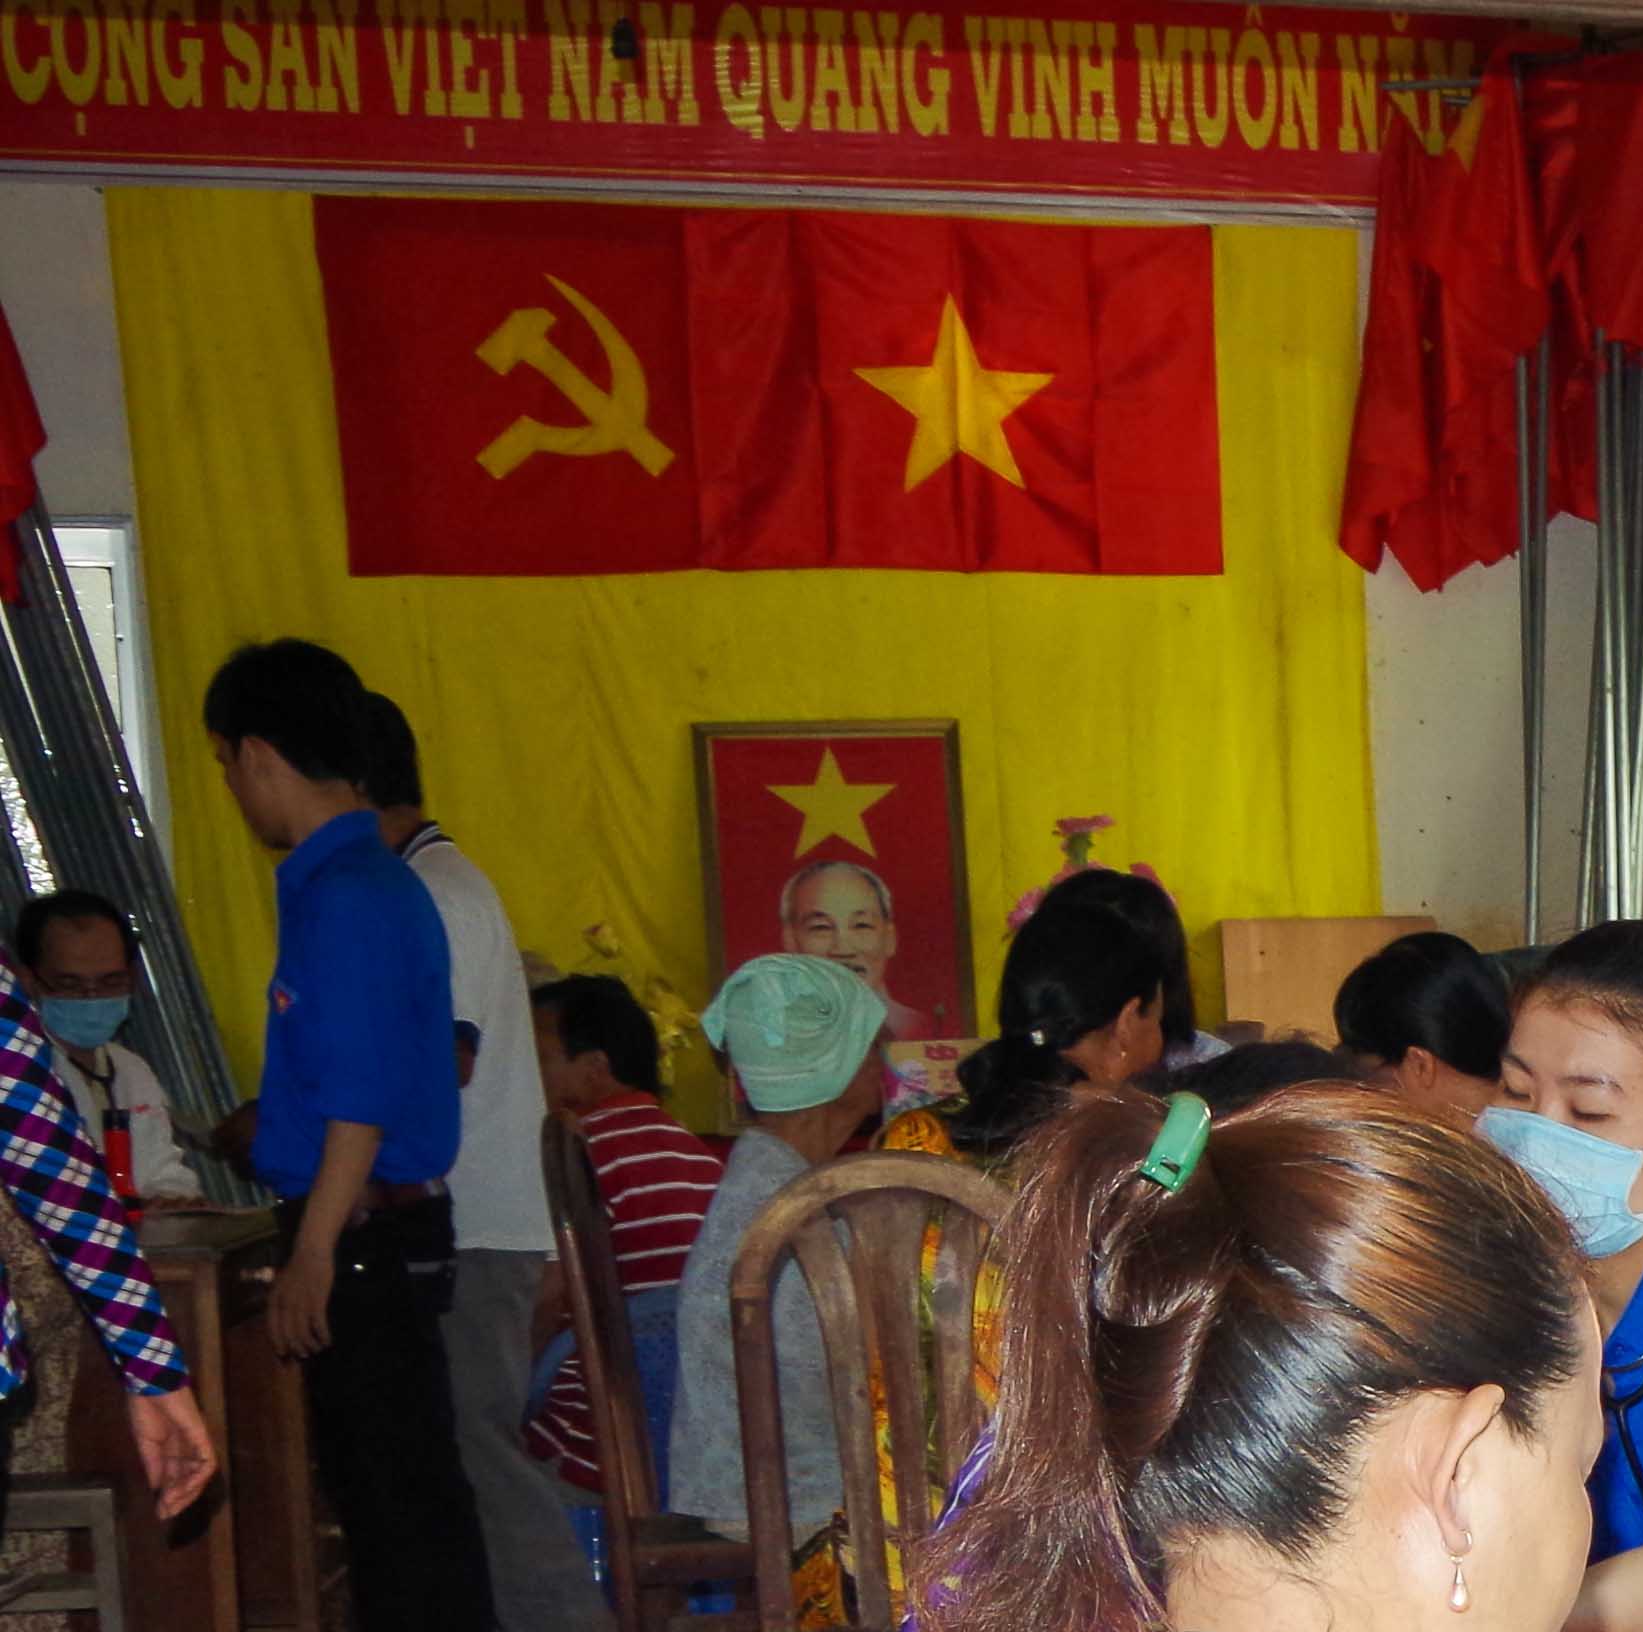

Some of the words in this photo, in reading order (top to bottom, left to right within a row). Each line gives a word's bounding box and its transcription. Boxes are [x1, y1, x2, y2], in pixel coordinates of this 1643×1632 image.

[547, 1, 700, 126] NAM
[712, 3, 950, 140] QUANG
[964, 14, 1120, 143] VINH
[1134, 5, 1320, 152] MUÔN
